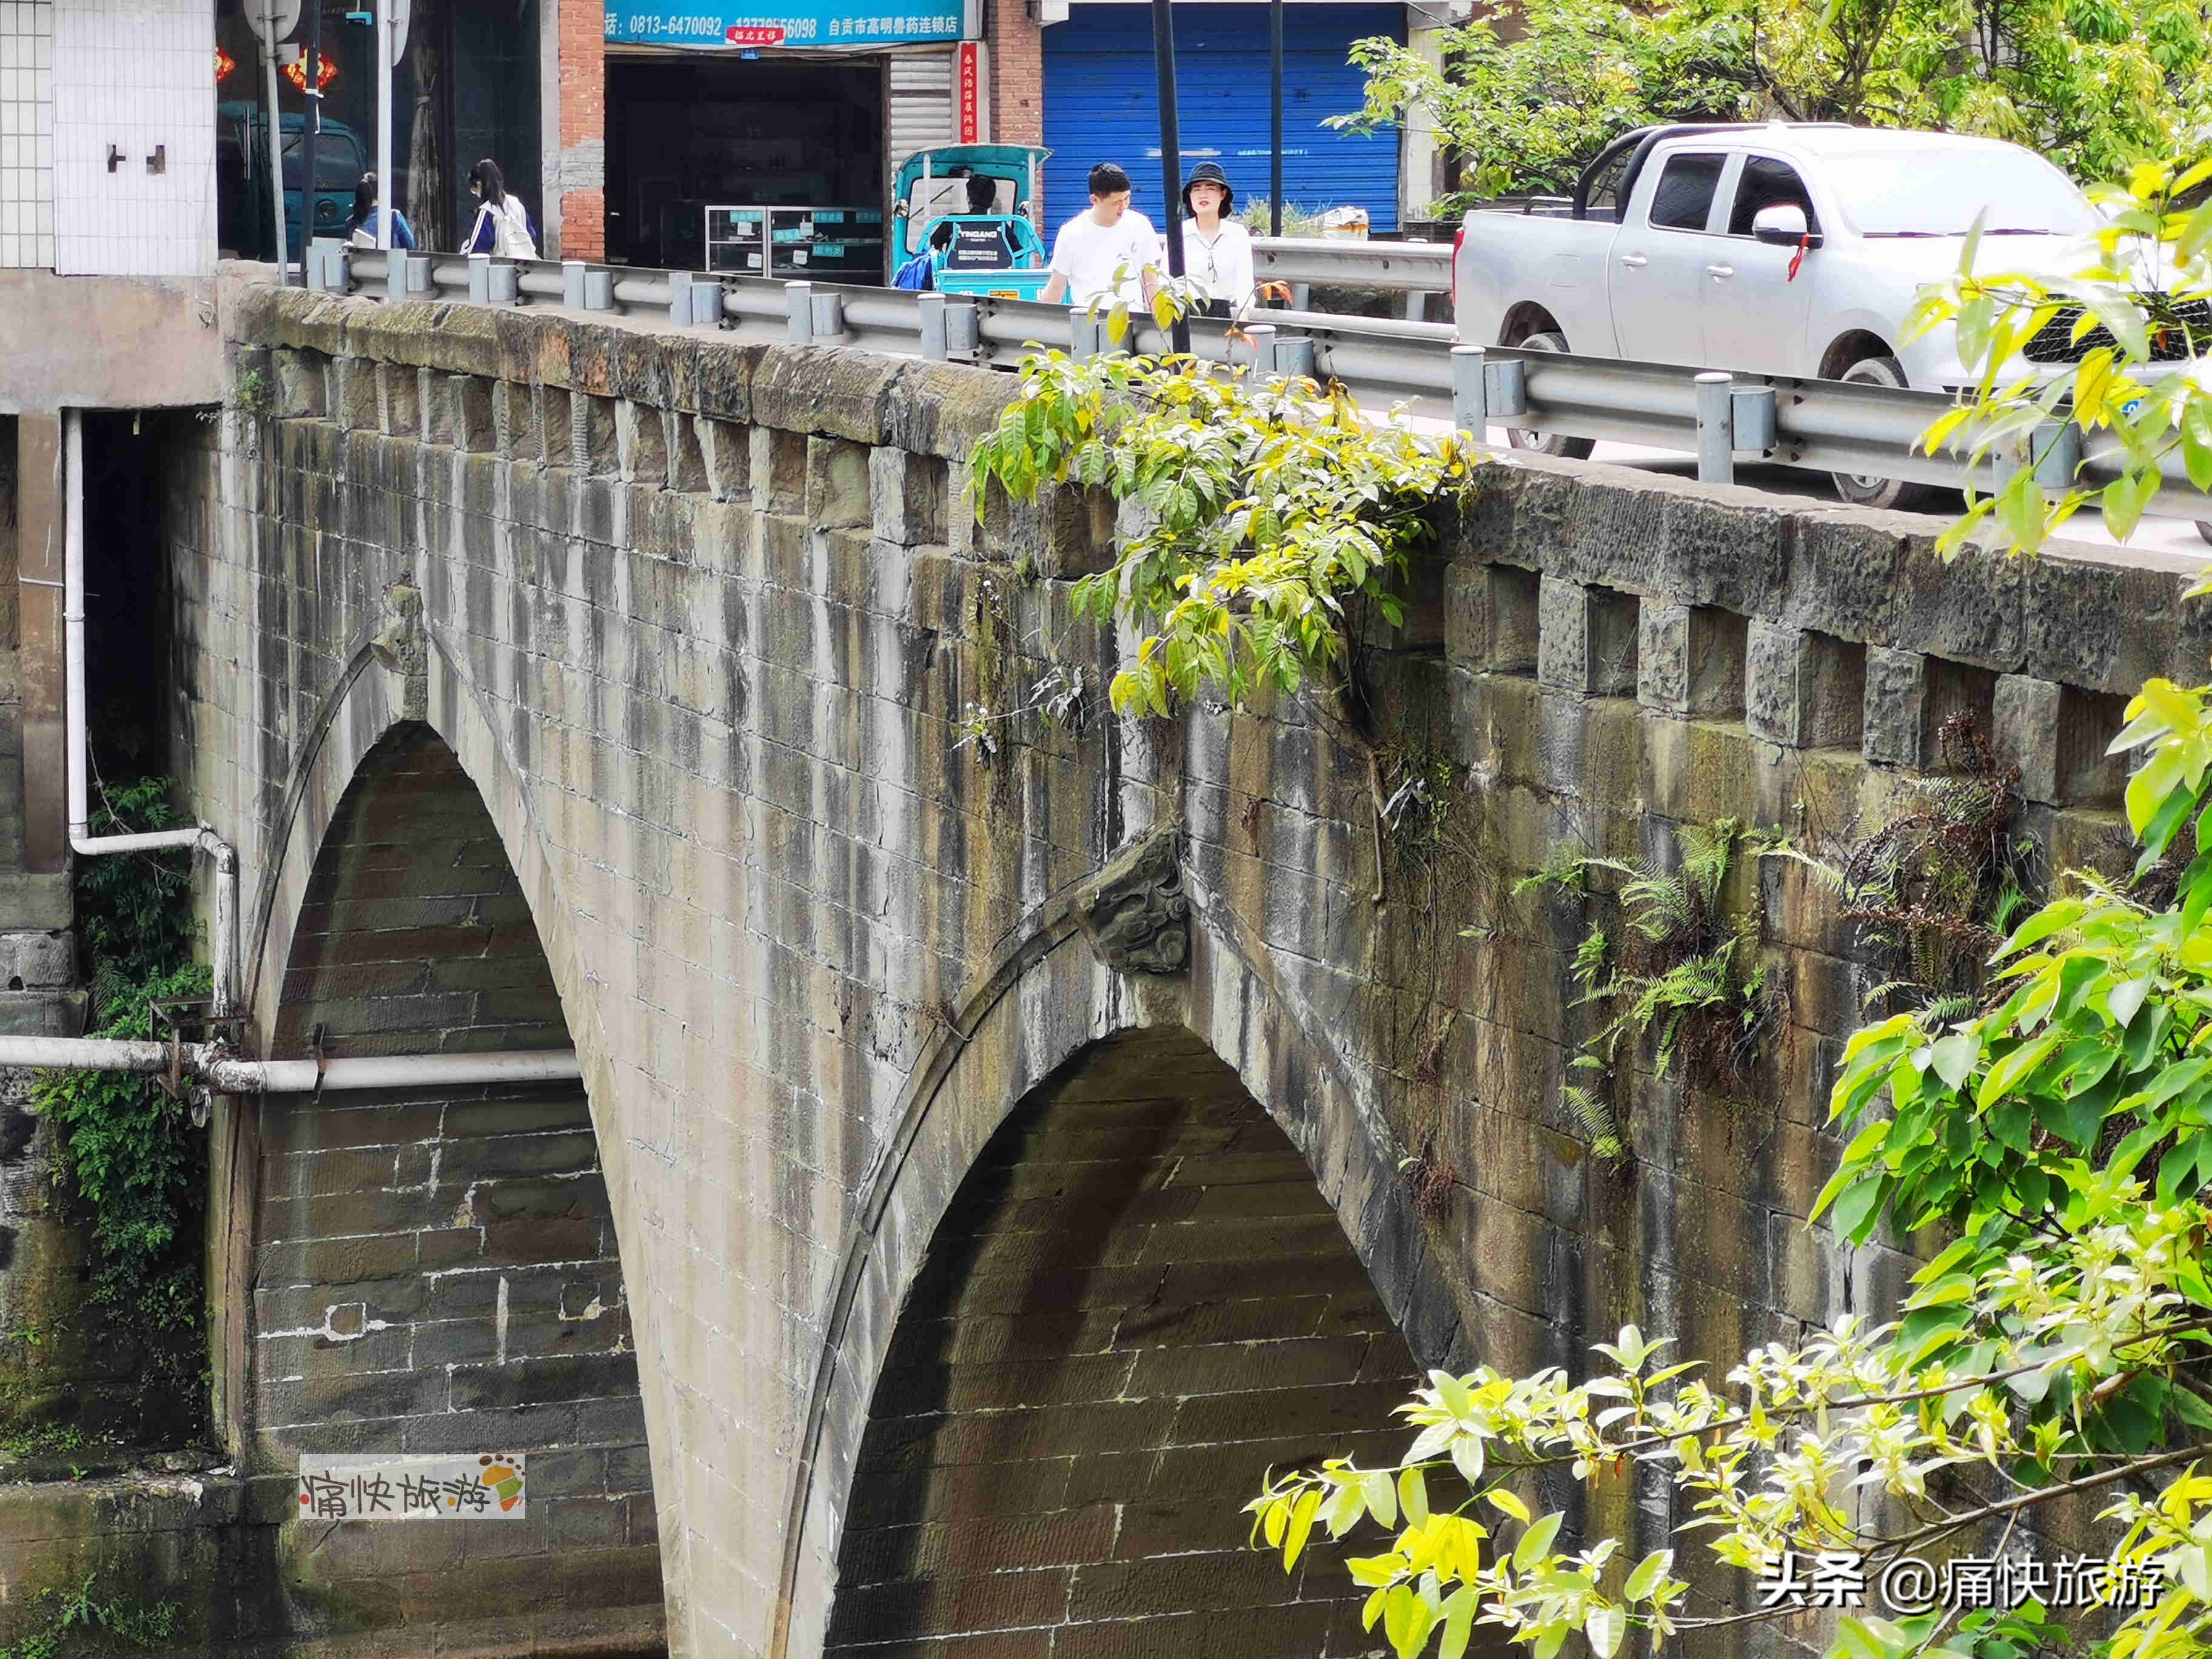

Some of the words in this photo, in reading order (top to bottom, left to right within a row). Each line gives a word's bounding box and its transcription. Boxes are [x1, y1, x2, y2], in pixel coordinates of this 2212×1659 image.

[630, 15, 722, 36] 0813-6470092
[829, 15, 957, 36] 自贡市高明兽药连锁店
